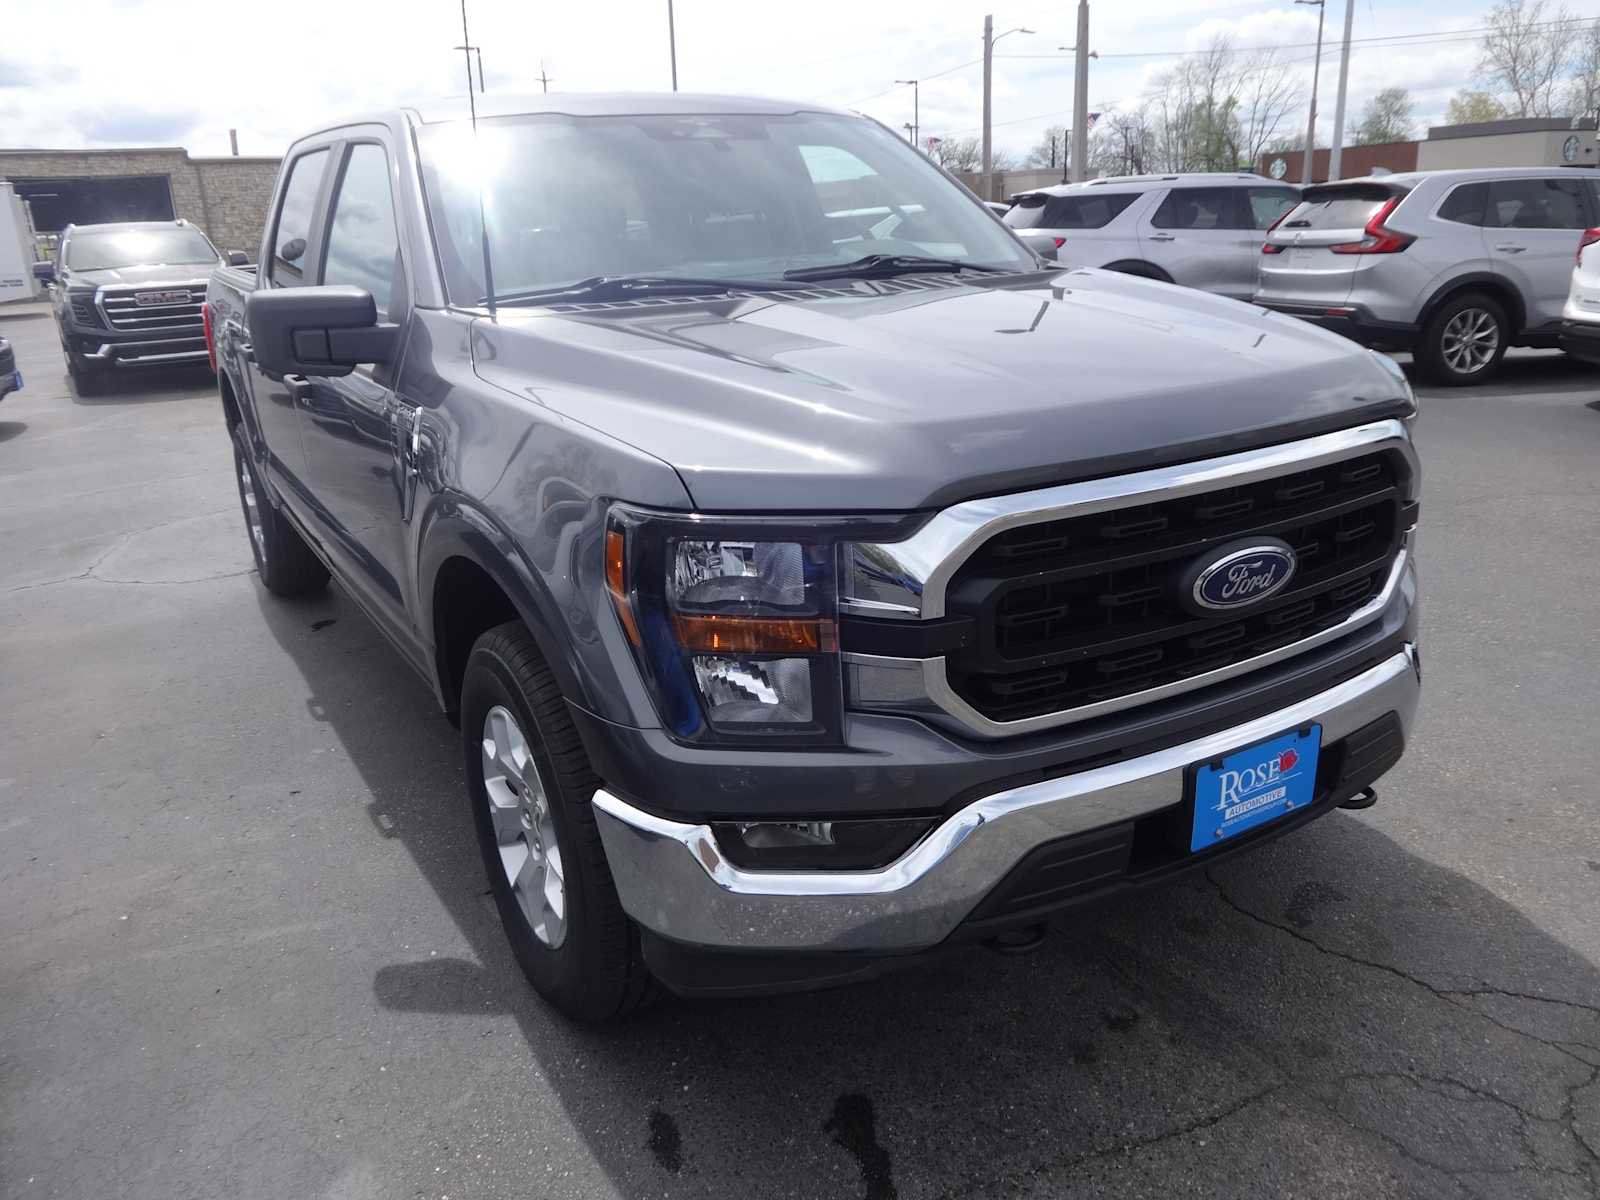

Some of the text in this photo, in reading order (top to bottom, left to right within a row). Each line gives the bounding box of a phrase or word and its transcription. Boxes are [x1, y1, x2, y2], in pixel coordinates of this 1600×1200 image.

[137, 292, 189, 304] GMC
[1222, 560, 1276, 598] Ford
[1216, 758, 1281, 810] ROSE
[1229, 789, 1284, 817] AUTOMOTIVE
